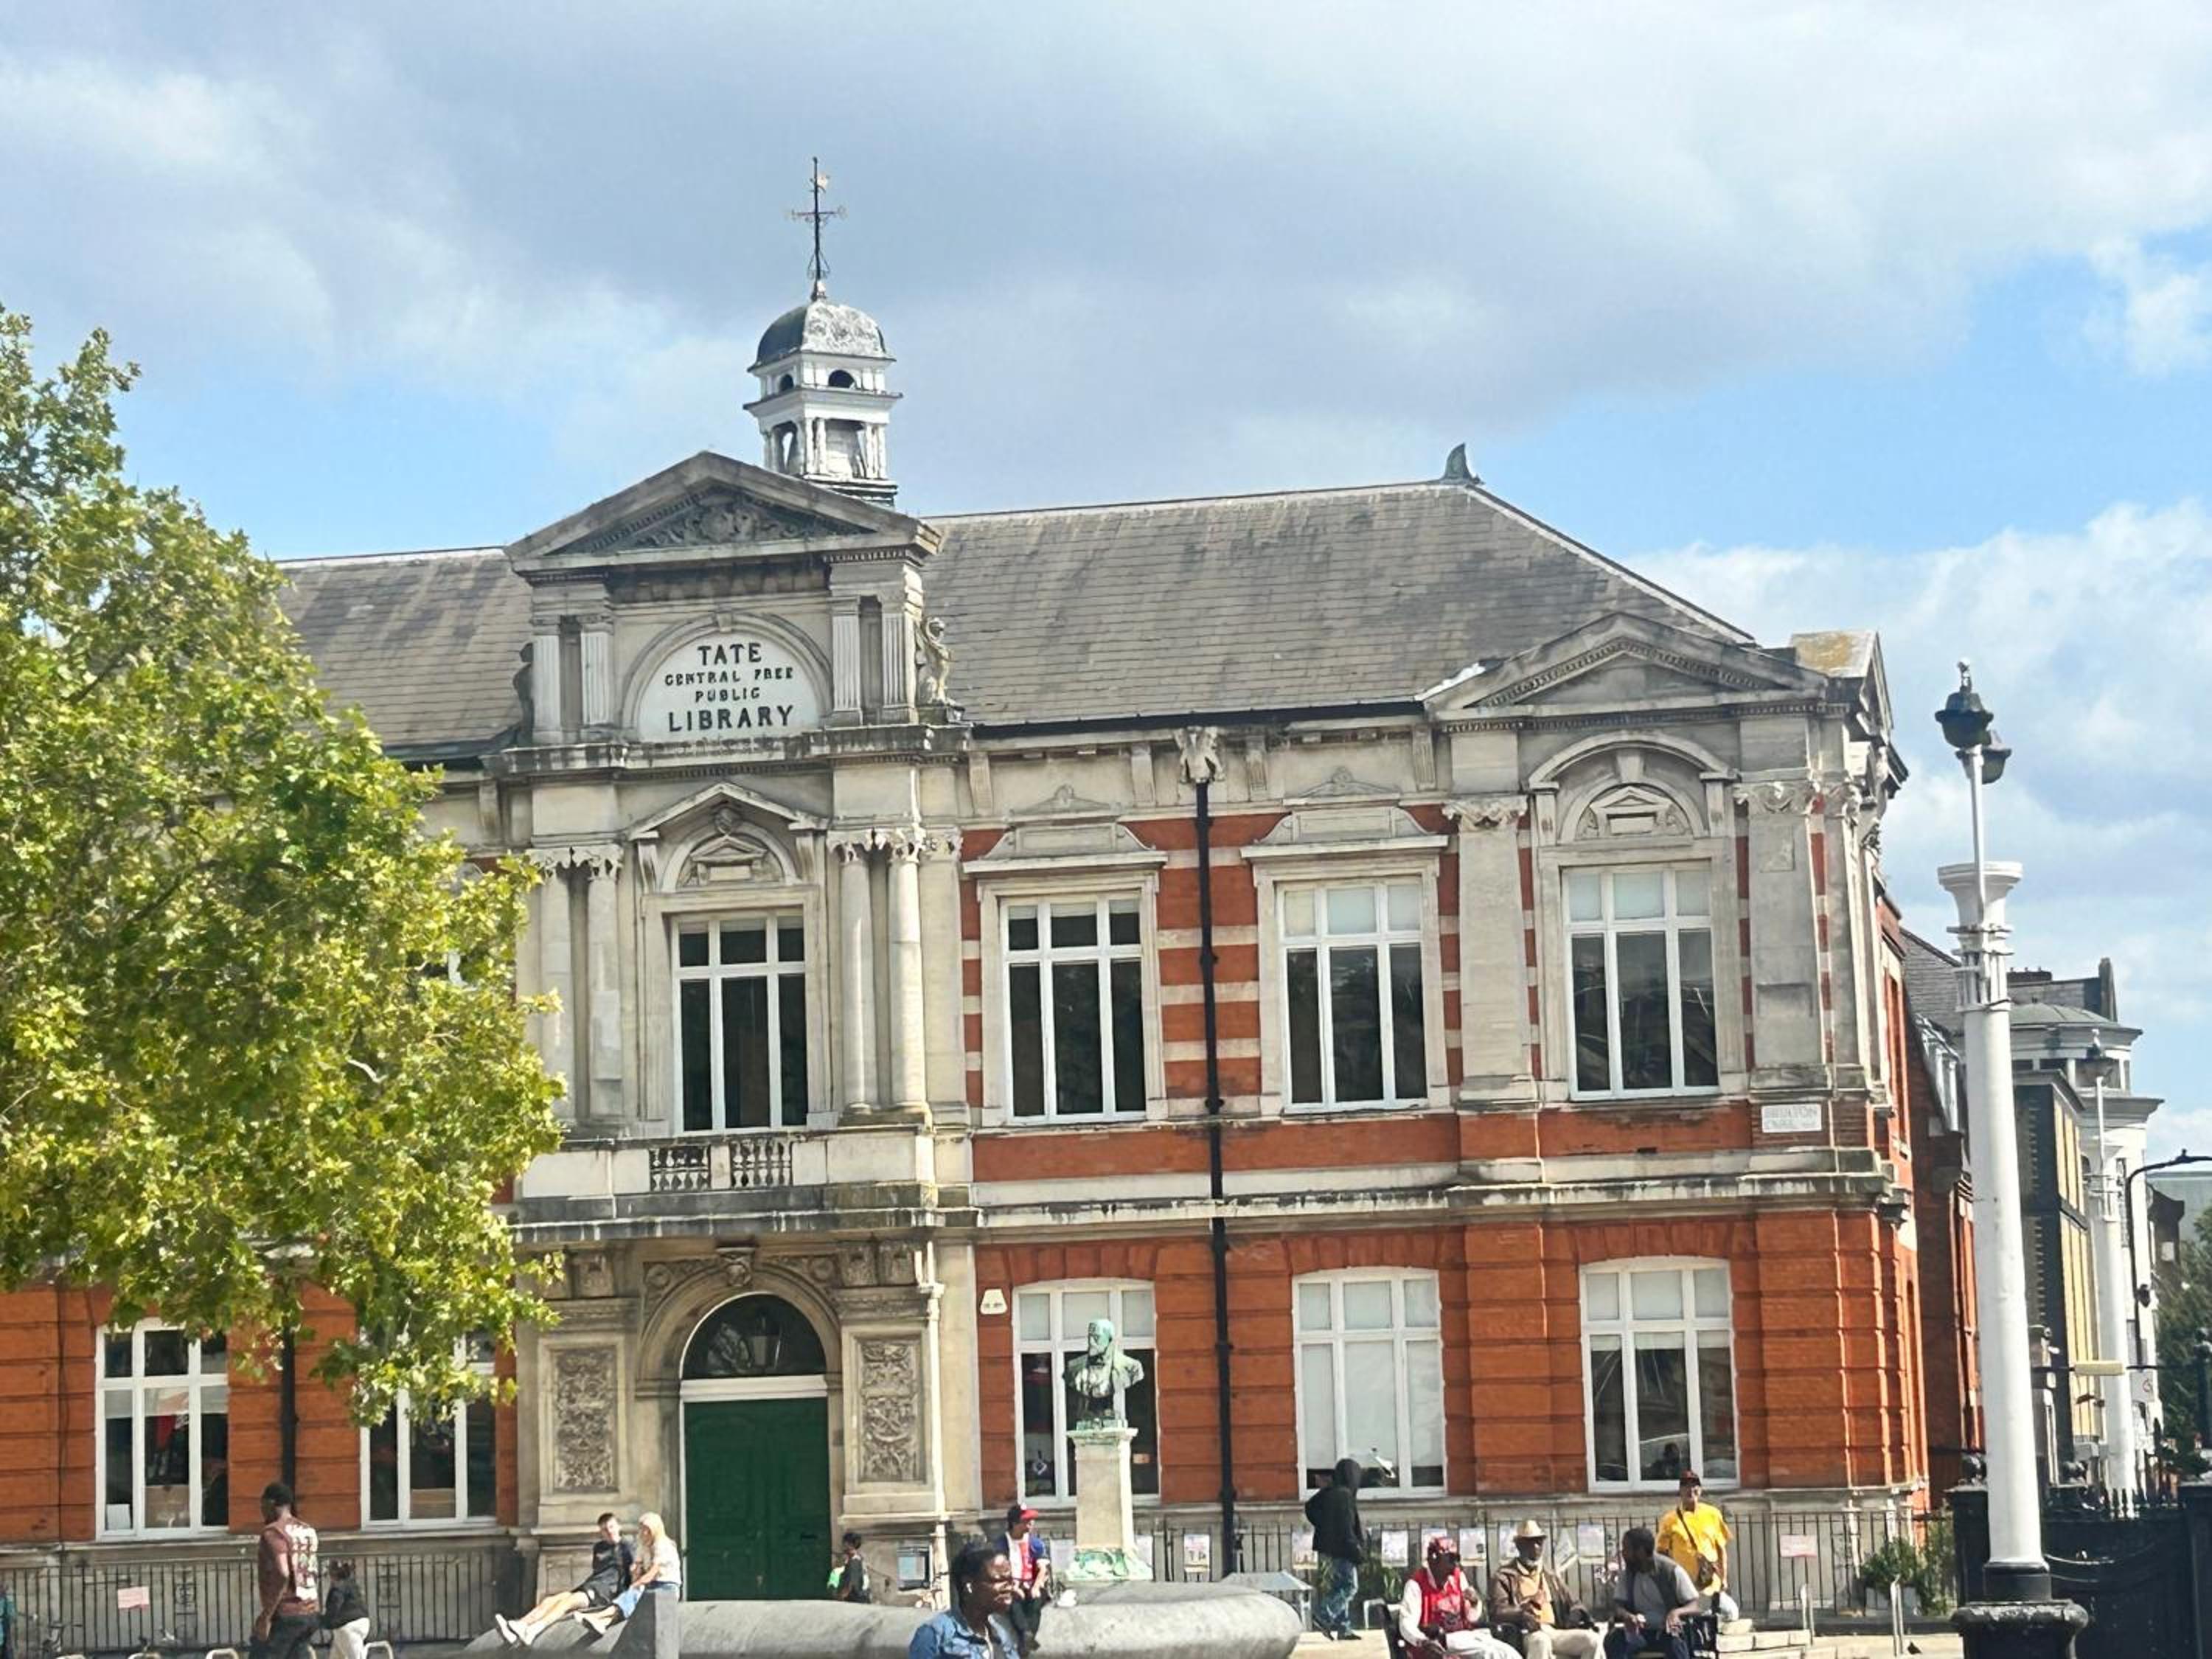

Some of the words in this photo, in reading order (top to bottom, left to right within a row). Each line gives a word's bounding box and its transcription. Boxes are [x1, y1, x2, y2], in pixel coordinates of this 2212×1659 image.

[698, 642, 762, 666] TATE
[664, 671, 741, 686] CENTRAL
[754, 667, 793, 681] FREE
[695, 687, 760, 703] PUBLIC
[668, 705, 793, 732] LIBRARY
